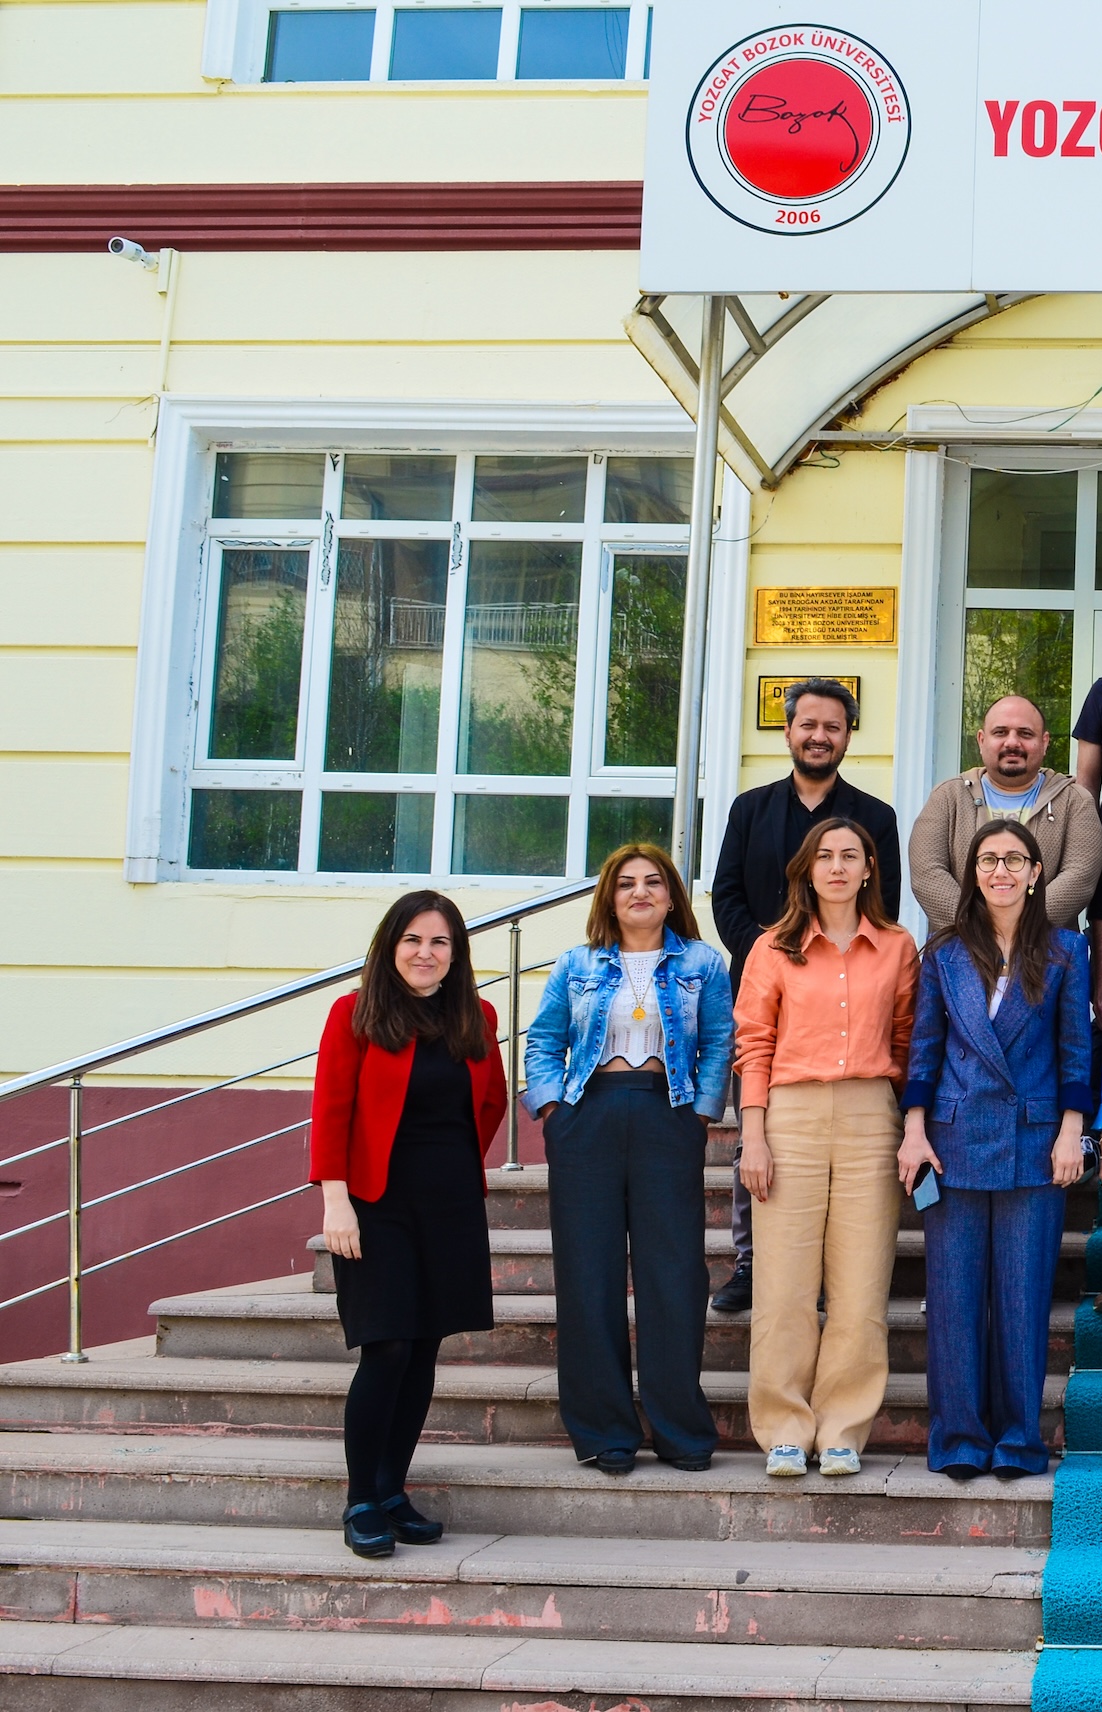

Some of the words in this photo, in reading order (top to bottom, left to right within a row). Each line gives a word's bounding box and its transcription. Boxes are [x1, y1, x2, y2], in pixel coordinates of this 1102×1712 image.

[697, 57, 741, 124] YOZGAT
[742, 32, 805, 62] BOZOK
[811, 30, 905, 124] ÜNİVERSİTESİ
[738, 94, 859, 173] Bozok
[775, 209, 821, 225] 2006
